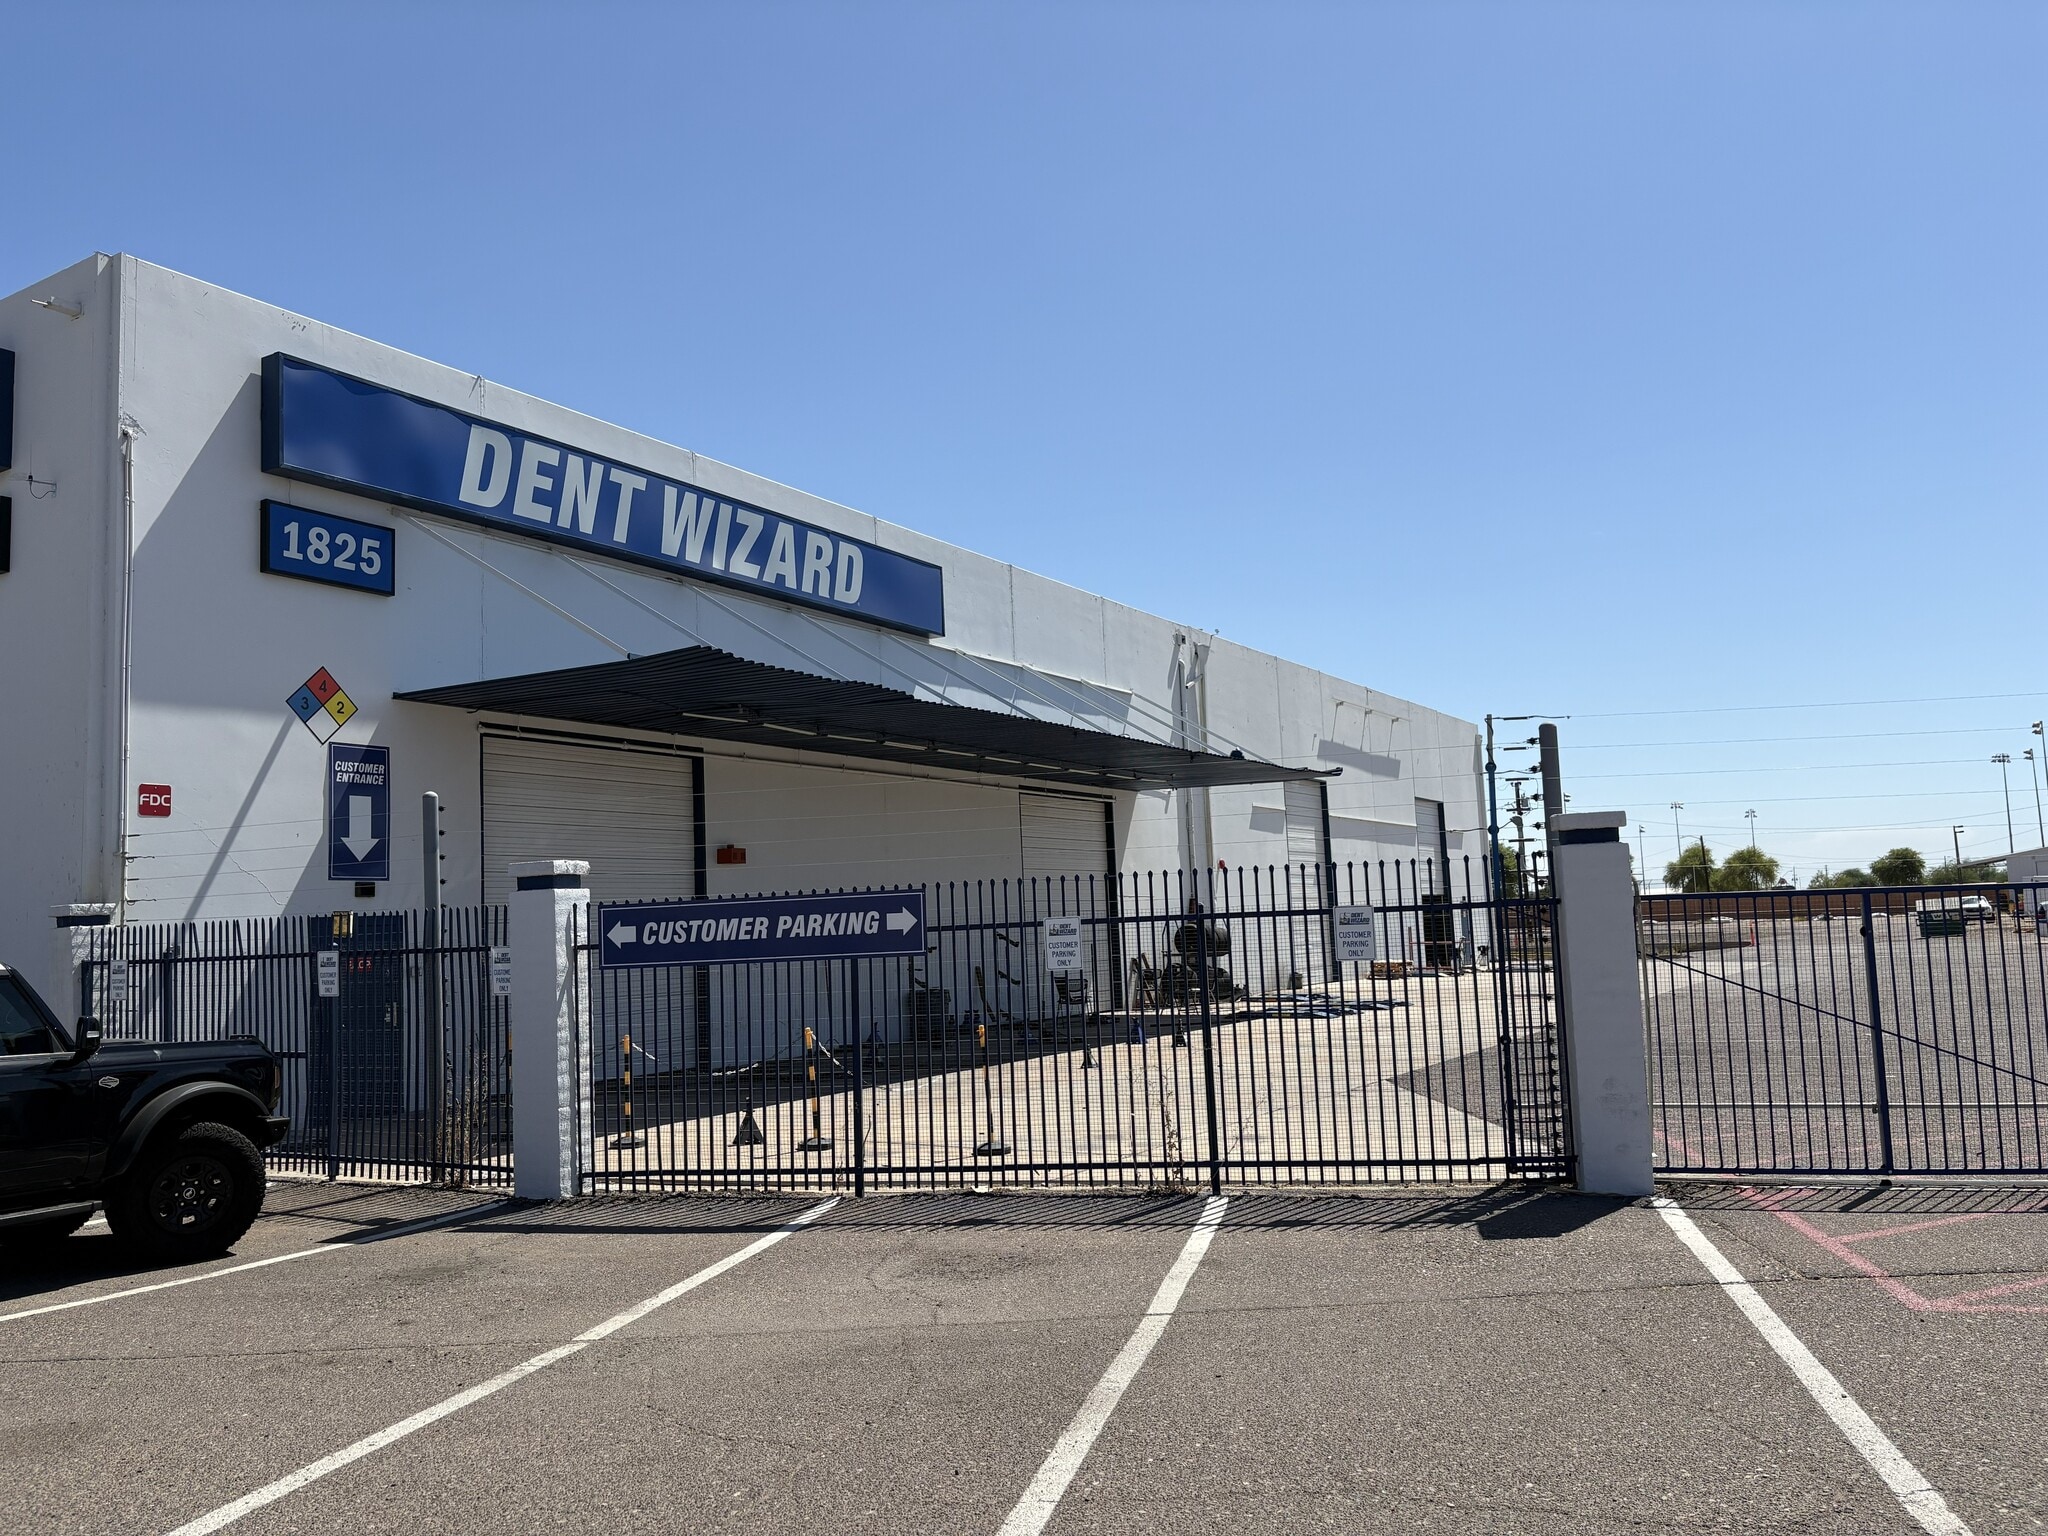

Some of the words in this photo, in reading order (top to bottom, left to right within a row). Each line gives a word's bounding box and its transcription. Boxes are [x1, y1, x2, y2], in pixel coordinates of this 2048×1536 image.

[458, 423, 647, 544] DENT
[660, 485, 864, 604] WIZARD
[283, 521, 382, 575] 1825
[319, 680, 328, 693] 4
[300, 696, 310, 710] 3
[336, 701, 345, 714] 2
[335, 760, 385, 774] CUSTOMER
[336, 772, 385, 785] ENTRANCE
[139, 793, 171, 807] FDC
[642, 916, 769, 945] CUSTOMER
[776, 910, 880, 938] PARKING
[1048, 941, 1079, 949] CUSTOMER
[1342, 940, 1369, 948] PARKING
[1052, 950, 1076, 958] PARKING
[1348, 949, 1364, 957] ONLY
